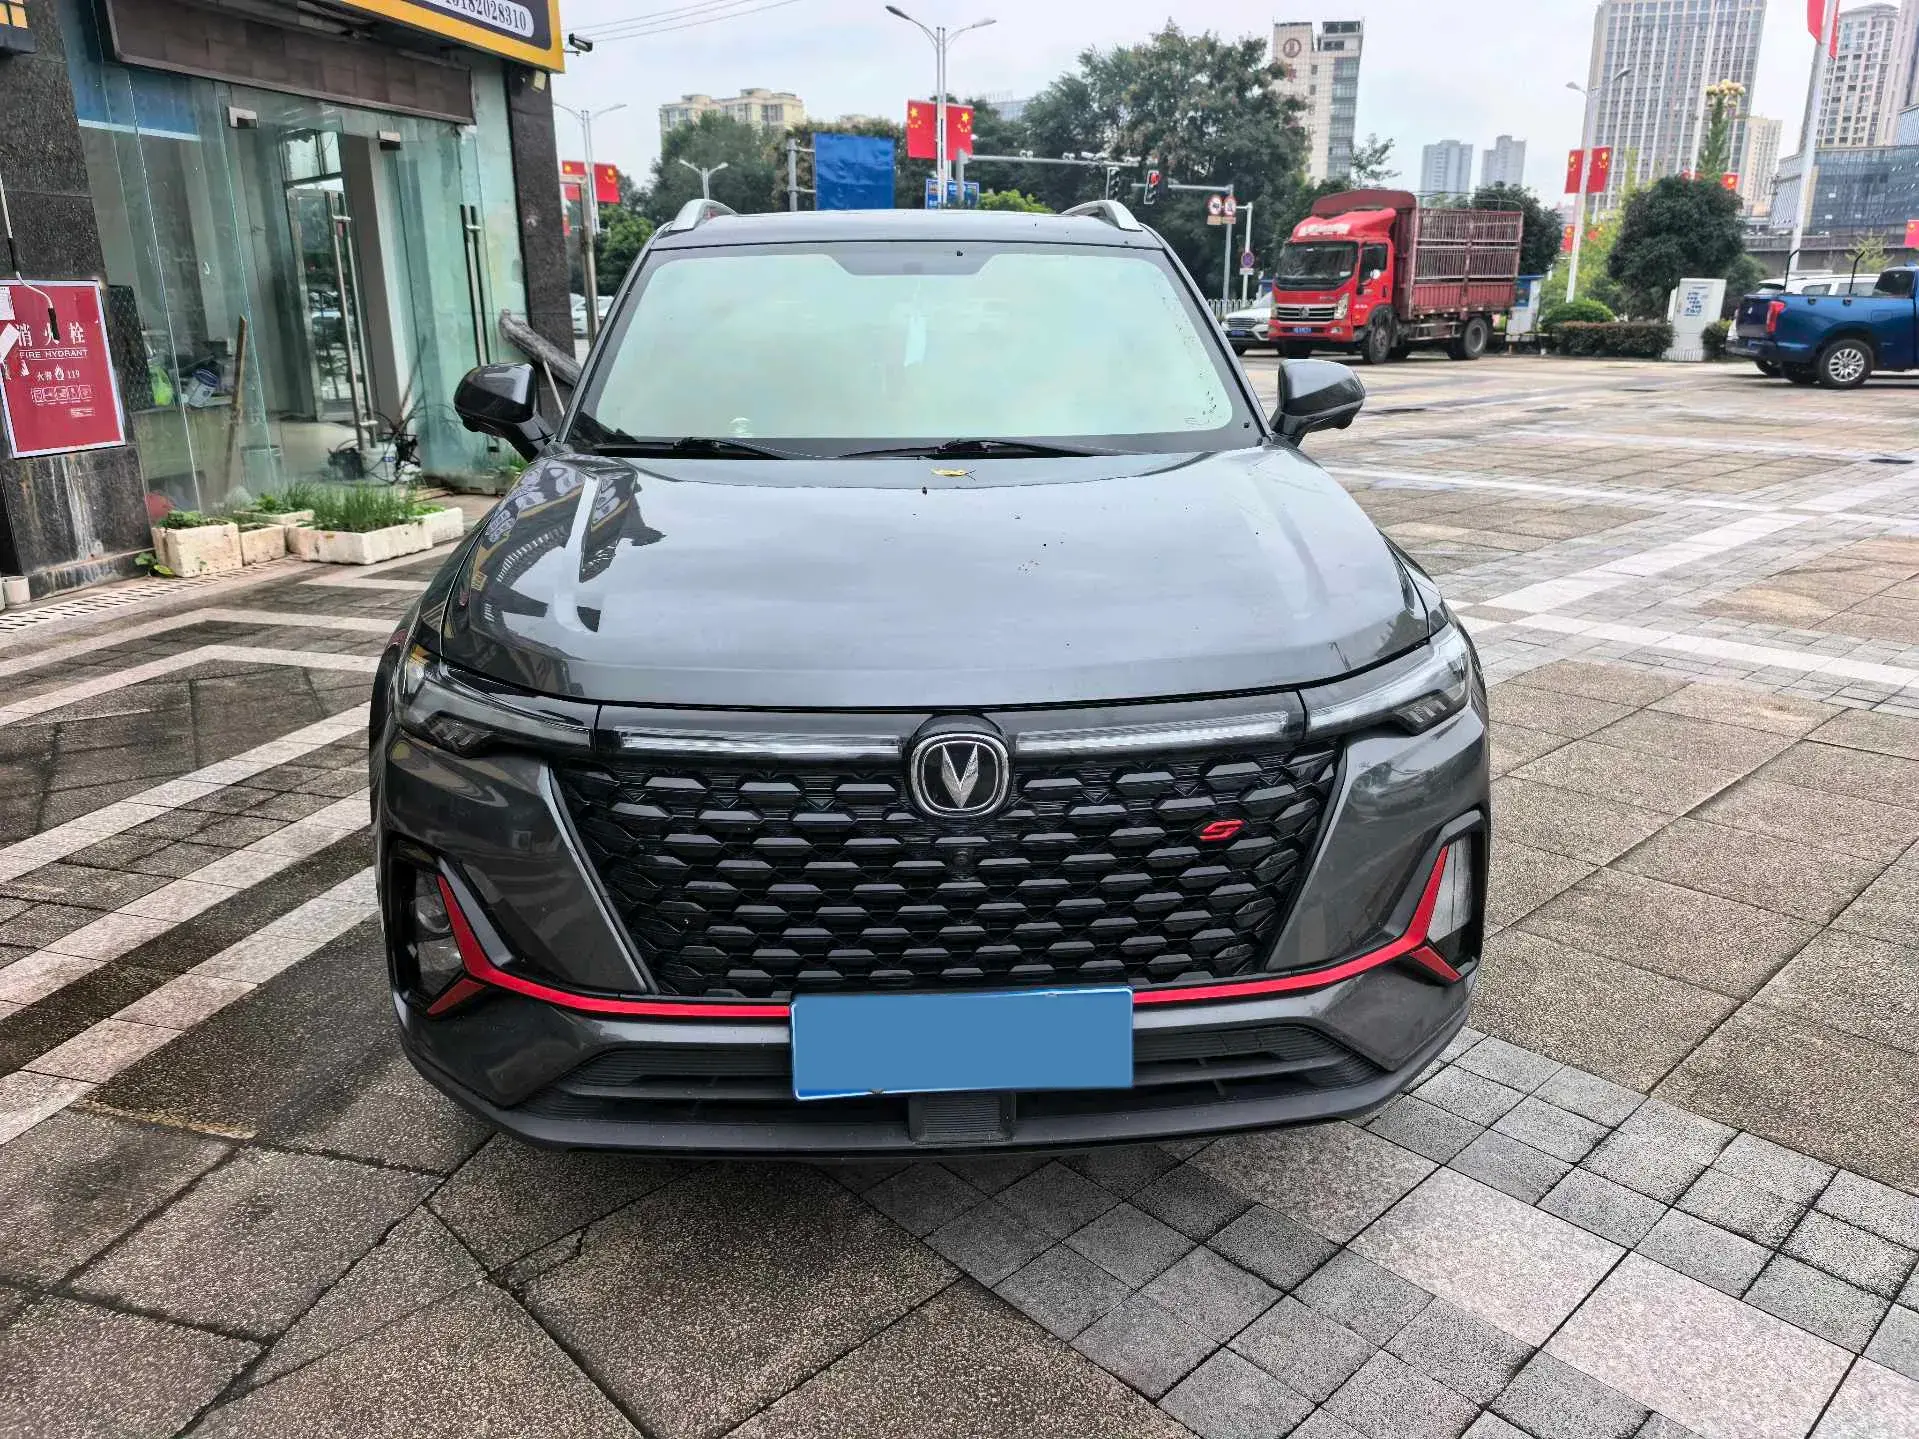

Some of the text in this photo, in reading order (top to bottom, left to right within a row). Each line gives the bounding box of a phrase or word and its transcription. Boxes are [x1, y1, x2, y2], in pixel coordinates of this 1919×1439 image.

[16, 321, 86, 347] 消火栓
[19, 349, 88, 359] FIRE HYDRANT
[67, 369, 80, 379] 119
